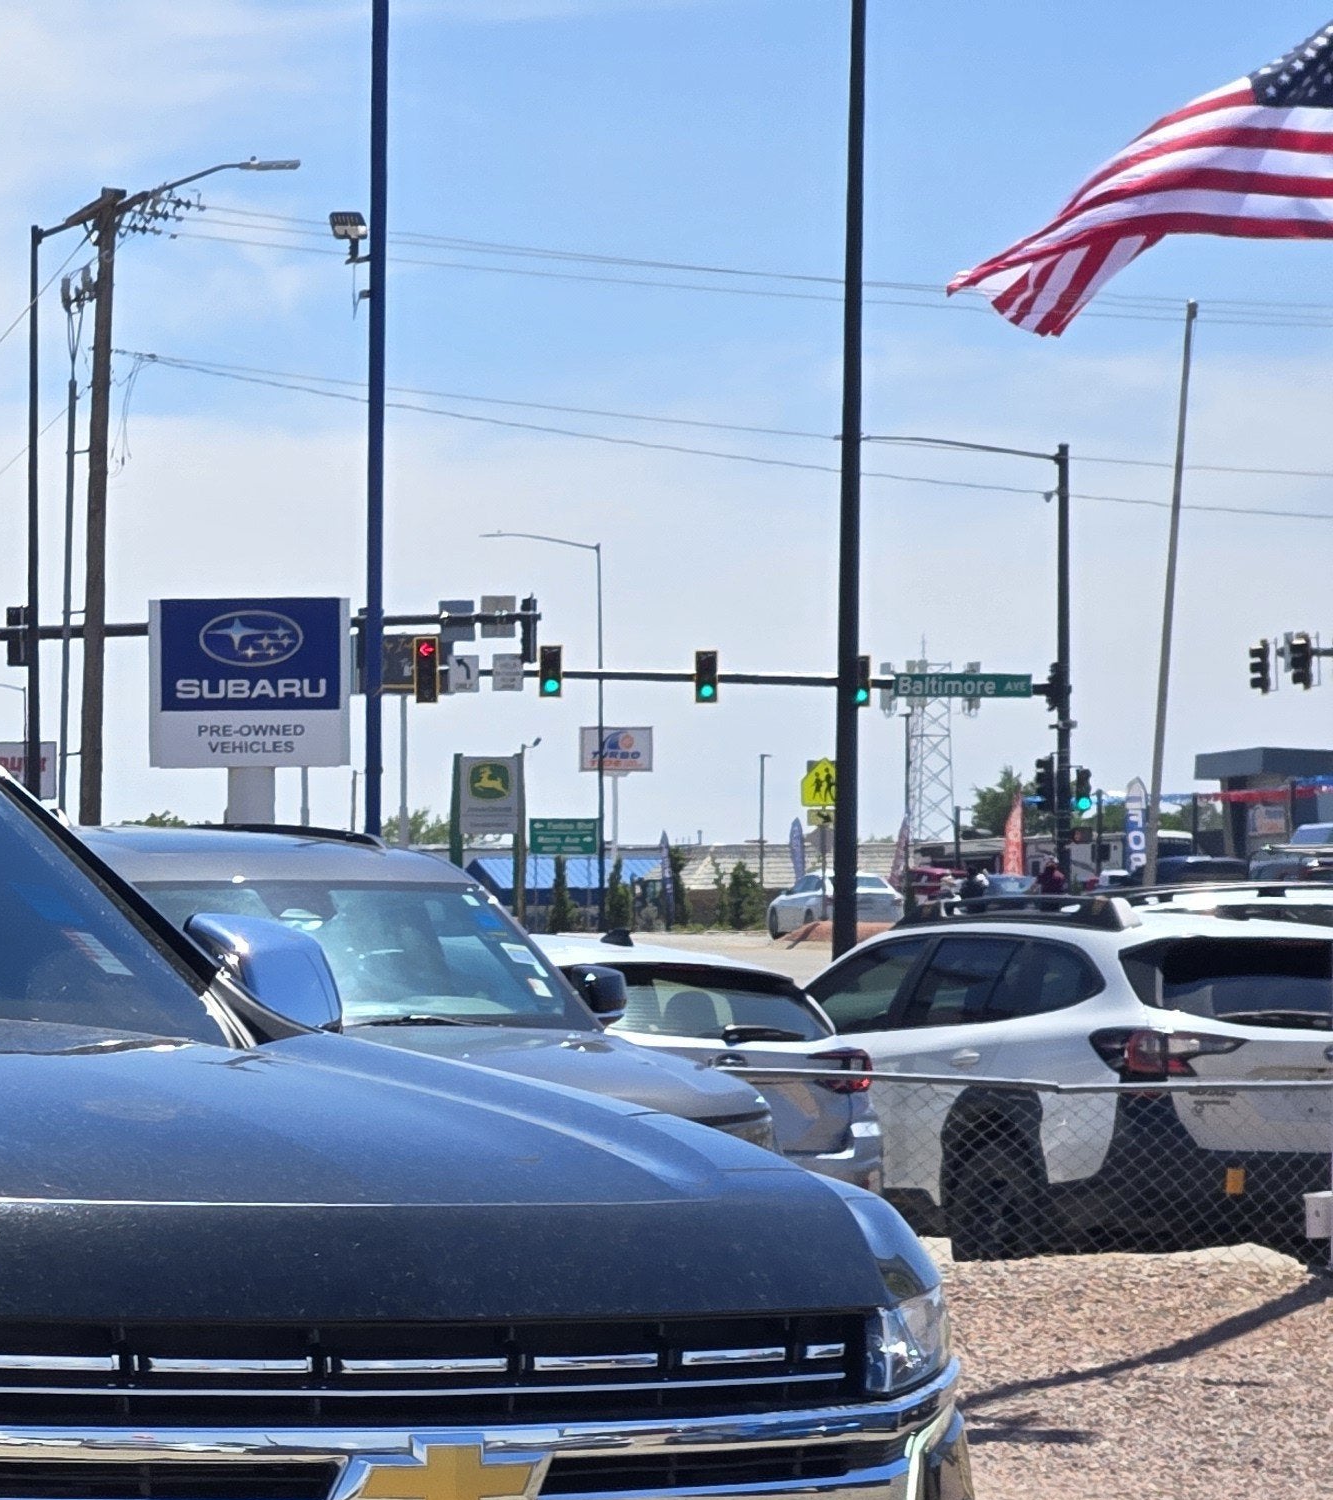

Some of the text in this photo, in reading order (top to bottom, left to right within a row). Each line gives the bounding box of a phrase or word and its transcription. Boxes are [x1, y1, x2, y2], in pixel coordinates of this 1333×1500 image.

[175, 678, 327, 699] SUBARU
[898, 676, 1027, 695] Baltimore AVE
[197, 724, 305, 737] PRE-OWNED
[208, 741, 295, 753] VEHICLES
